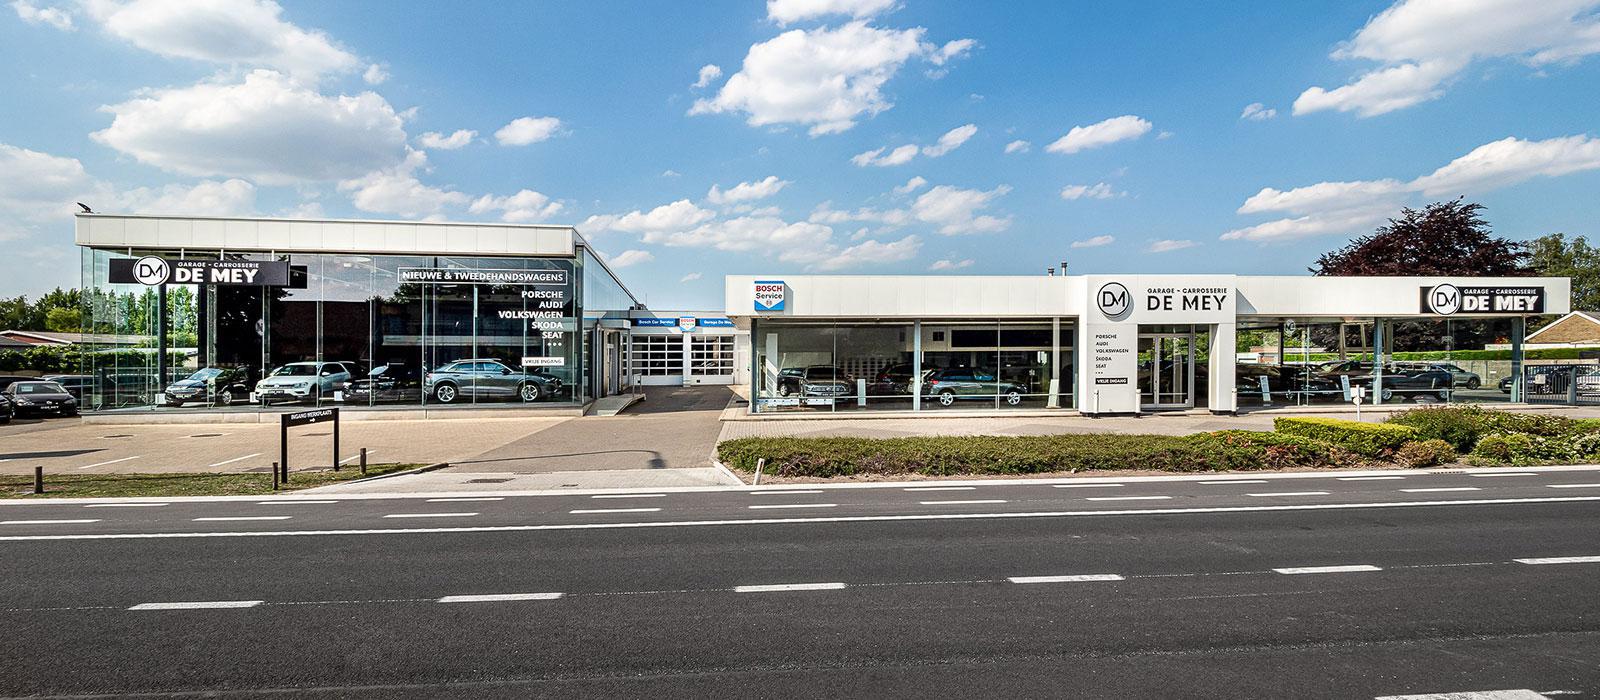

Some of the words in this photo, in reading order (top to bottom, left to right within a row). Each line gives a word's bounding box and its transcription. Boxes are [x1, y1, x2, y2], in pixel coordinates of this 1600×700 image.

[175, 268, 204, 282] DE
[211, 268, 258, 283] MEY
[402, 271, 442, 280] NIEUWE
[444, 272, 452, 280] &
[454, 272, 564, 281] TWEEDEHANDSWAGENS
[521, 290, 564, 298] PORSCHE
[539, 301, 564, 309] AUDI
[1147, 295, 1173, 311] DE
[1182, 295, 1227, 311] MEY
[1463, 296, 1489, 311] DE
[1495, 295, 1539, 311] MEY
[498, 310, 564, 319] VOLKSWAGEN
[542, 331, 564, 339] SEAT
